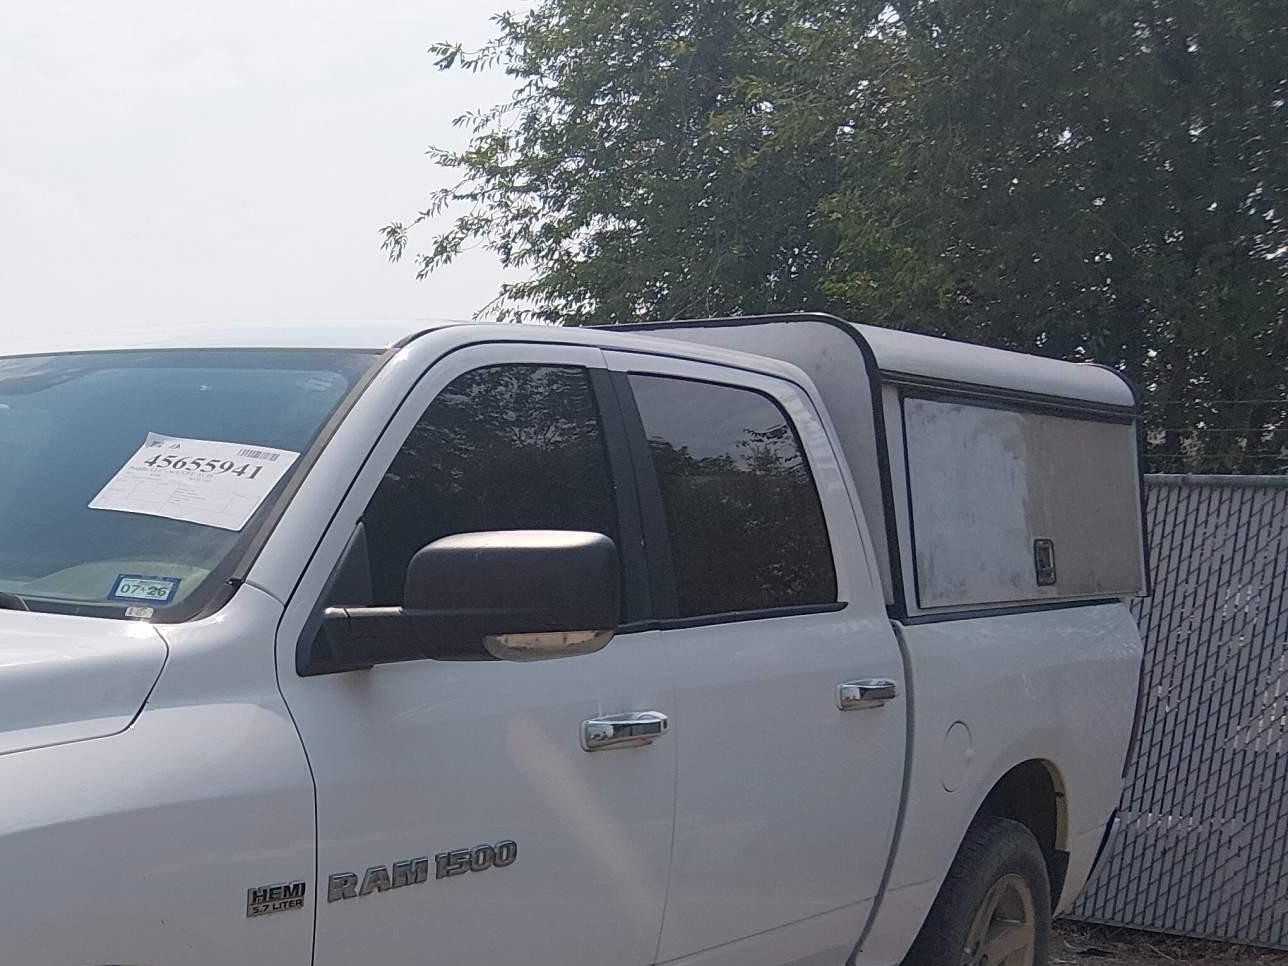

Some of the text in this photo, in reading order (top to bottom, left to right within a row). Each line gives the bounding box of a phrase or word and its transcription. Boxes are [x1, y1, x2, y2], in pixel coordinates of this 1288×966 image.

[144, 453, 264, 480] 45655941
[327, 839, 518, 903] RAM 1500
[250, 882, 306, 904] HEMI
[252, 898, 303, 914] 5.7 LITER
